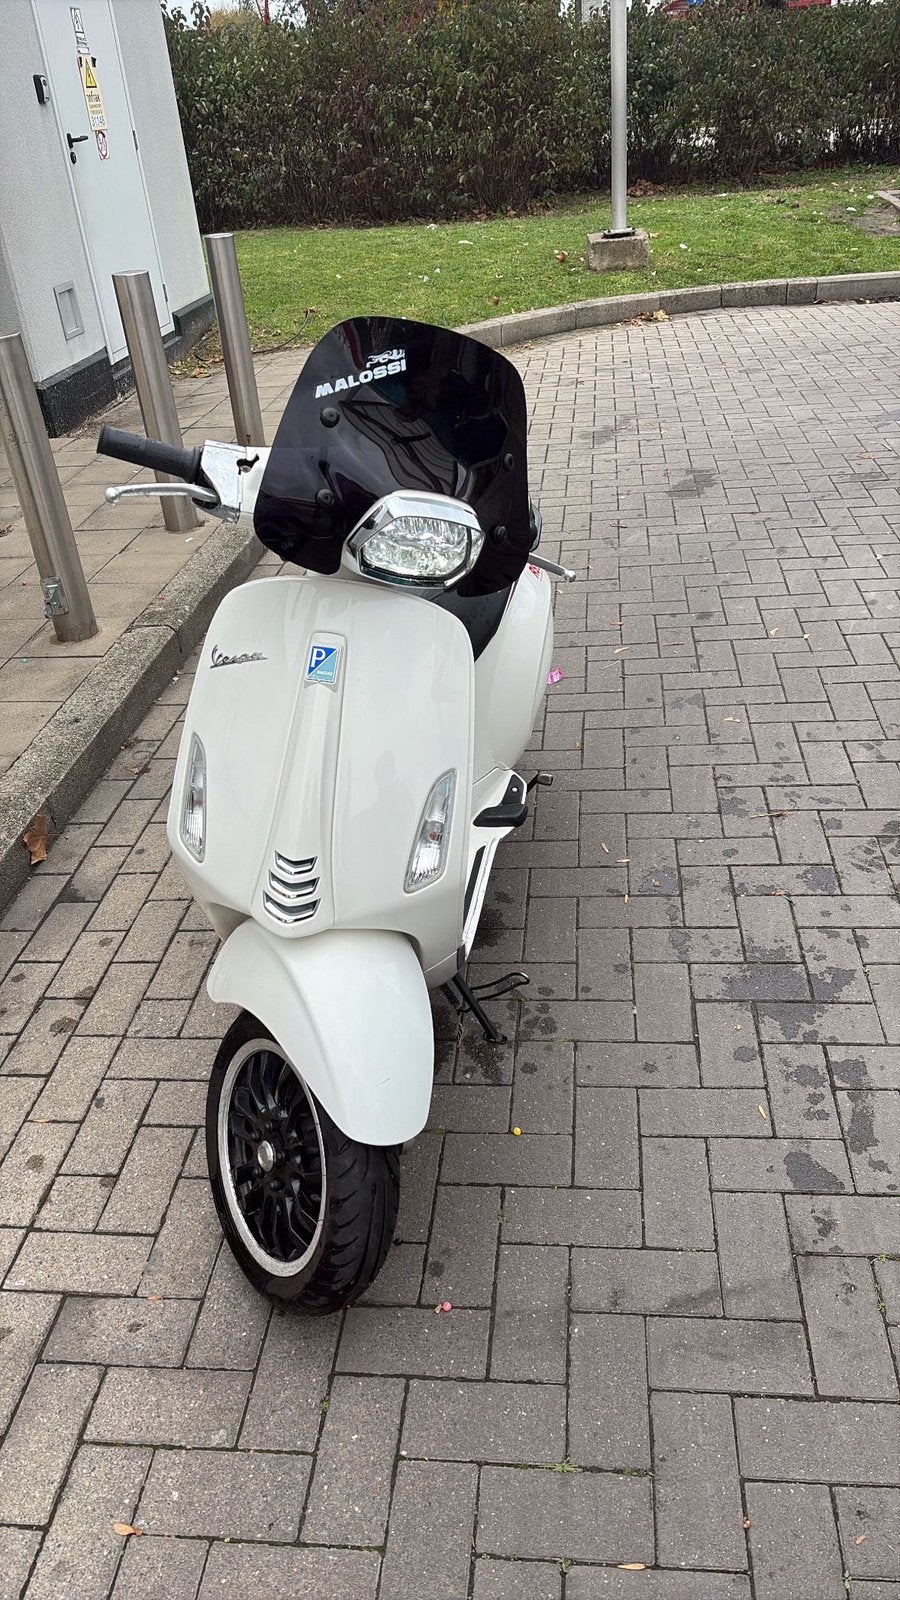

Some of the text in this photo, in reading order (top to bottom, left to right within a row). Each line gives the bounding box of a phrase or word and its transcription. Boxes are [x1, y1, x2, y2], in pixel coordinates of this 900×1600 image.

[315, 359, 407, 398] MALOSSI
[210, 645, 268, 669] Vespa
[310, 648, 326, 668] P
